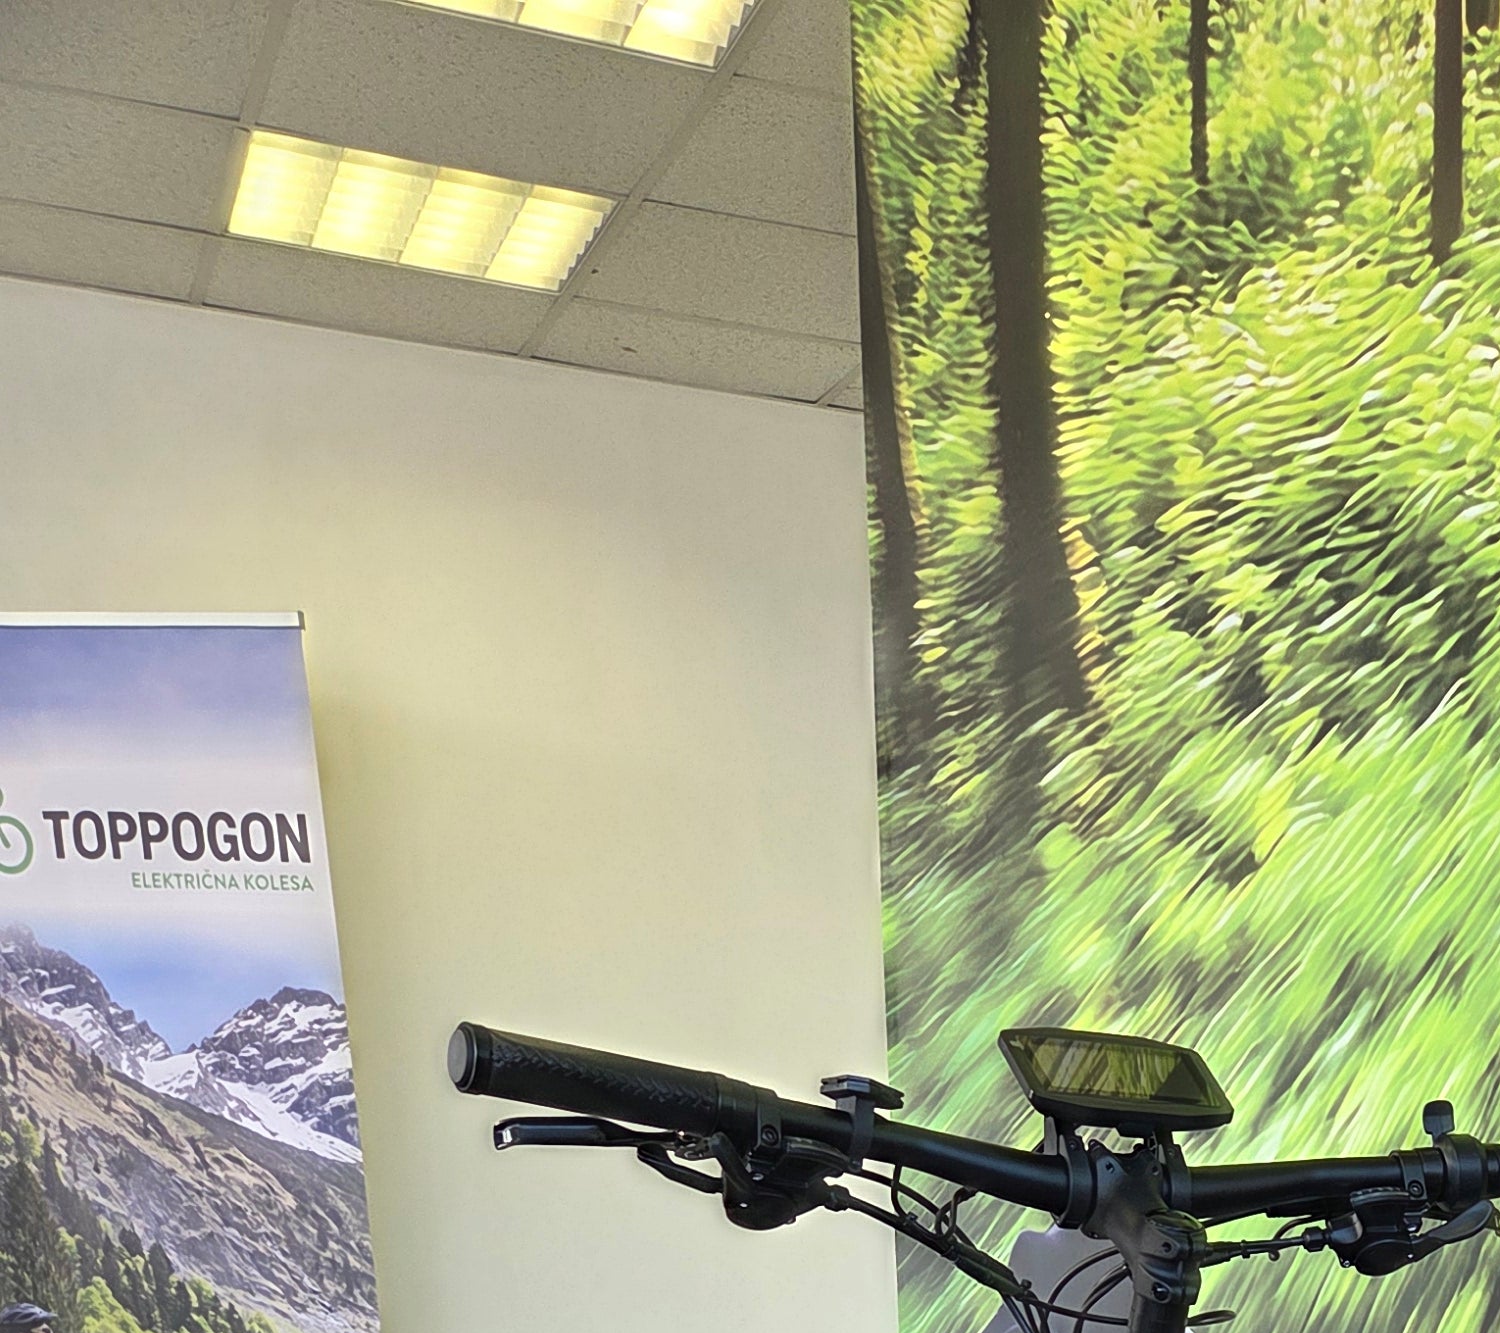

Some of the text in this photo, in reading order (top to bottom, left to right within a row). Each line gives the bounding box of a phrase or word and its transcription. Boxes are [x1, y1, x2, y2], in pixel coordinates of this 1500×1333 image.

[42, 810, 312, 864] TOPPOGON
[131, 868, 314, 892] ELEKTRIČNA KOLESA
